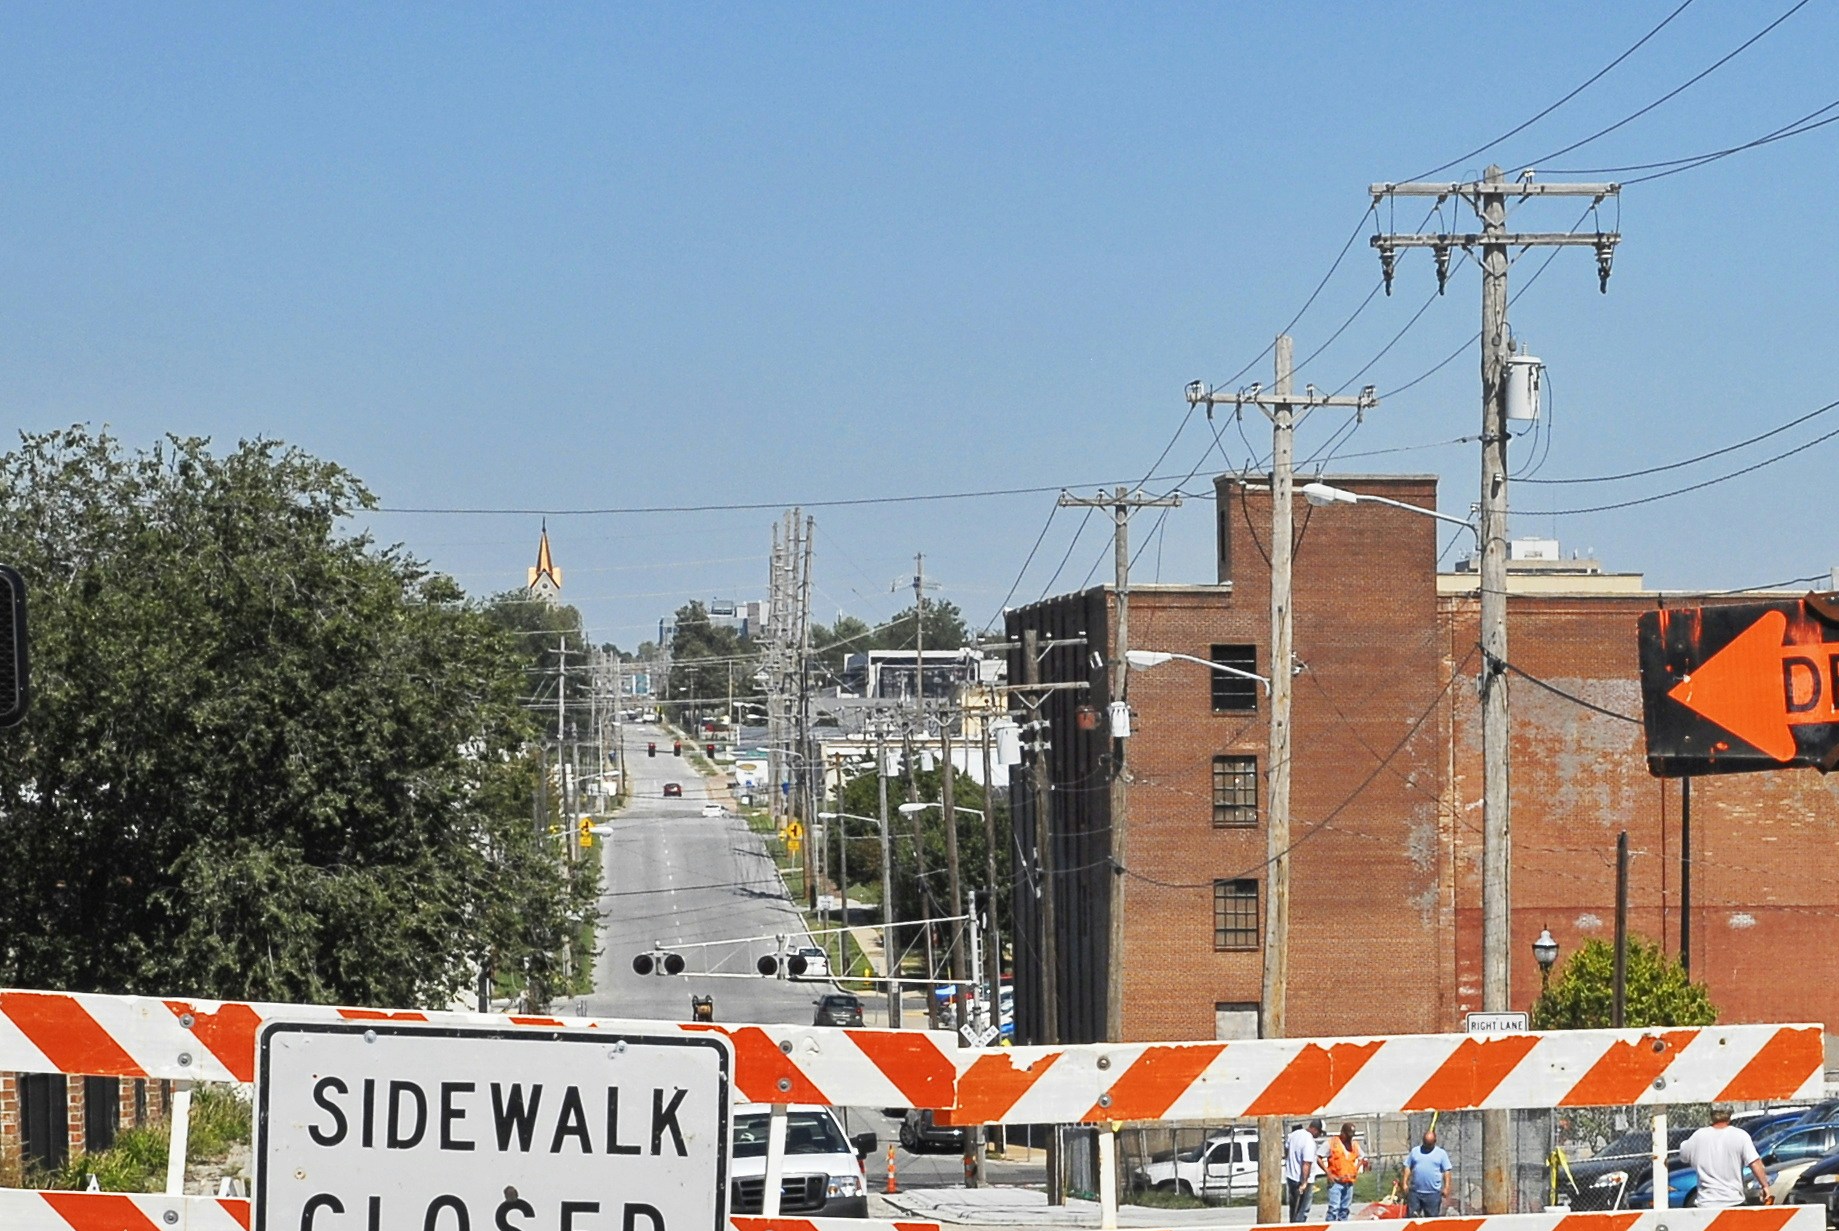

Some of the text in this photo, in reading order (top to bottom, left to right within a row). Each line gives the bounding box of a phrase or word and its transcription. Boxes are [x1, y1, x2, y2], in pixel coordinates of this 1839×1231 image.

[1471, 1021, 1524, 1031] RIGHT LANE
[309, 1075, 688, 1157] SIDEWALK
